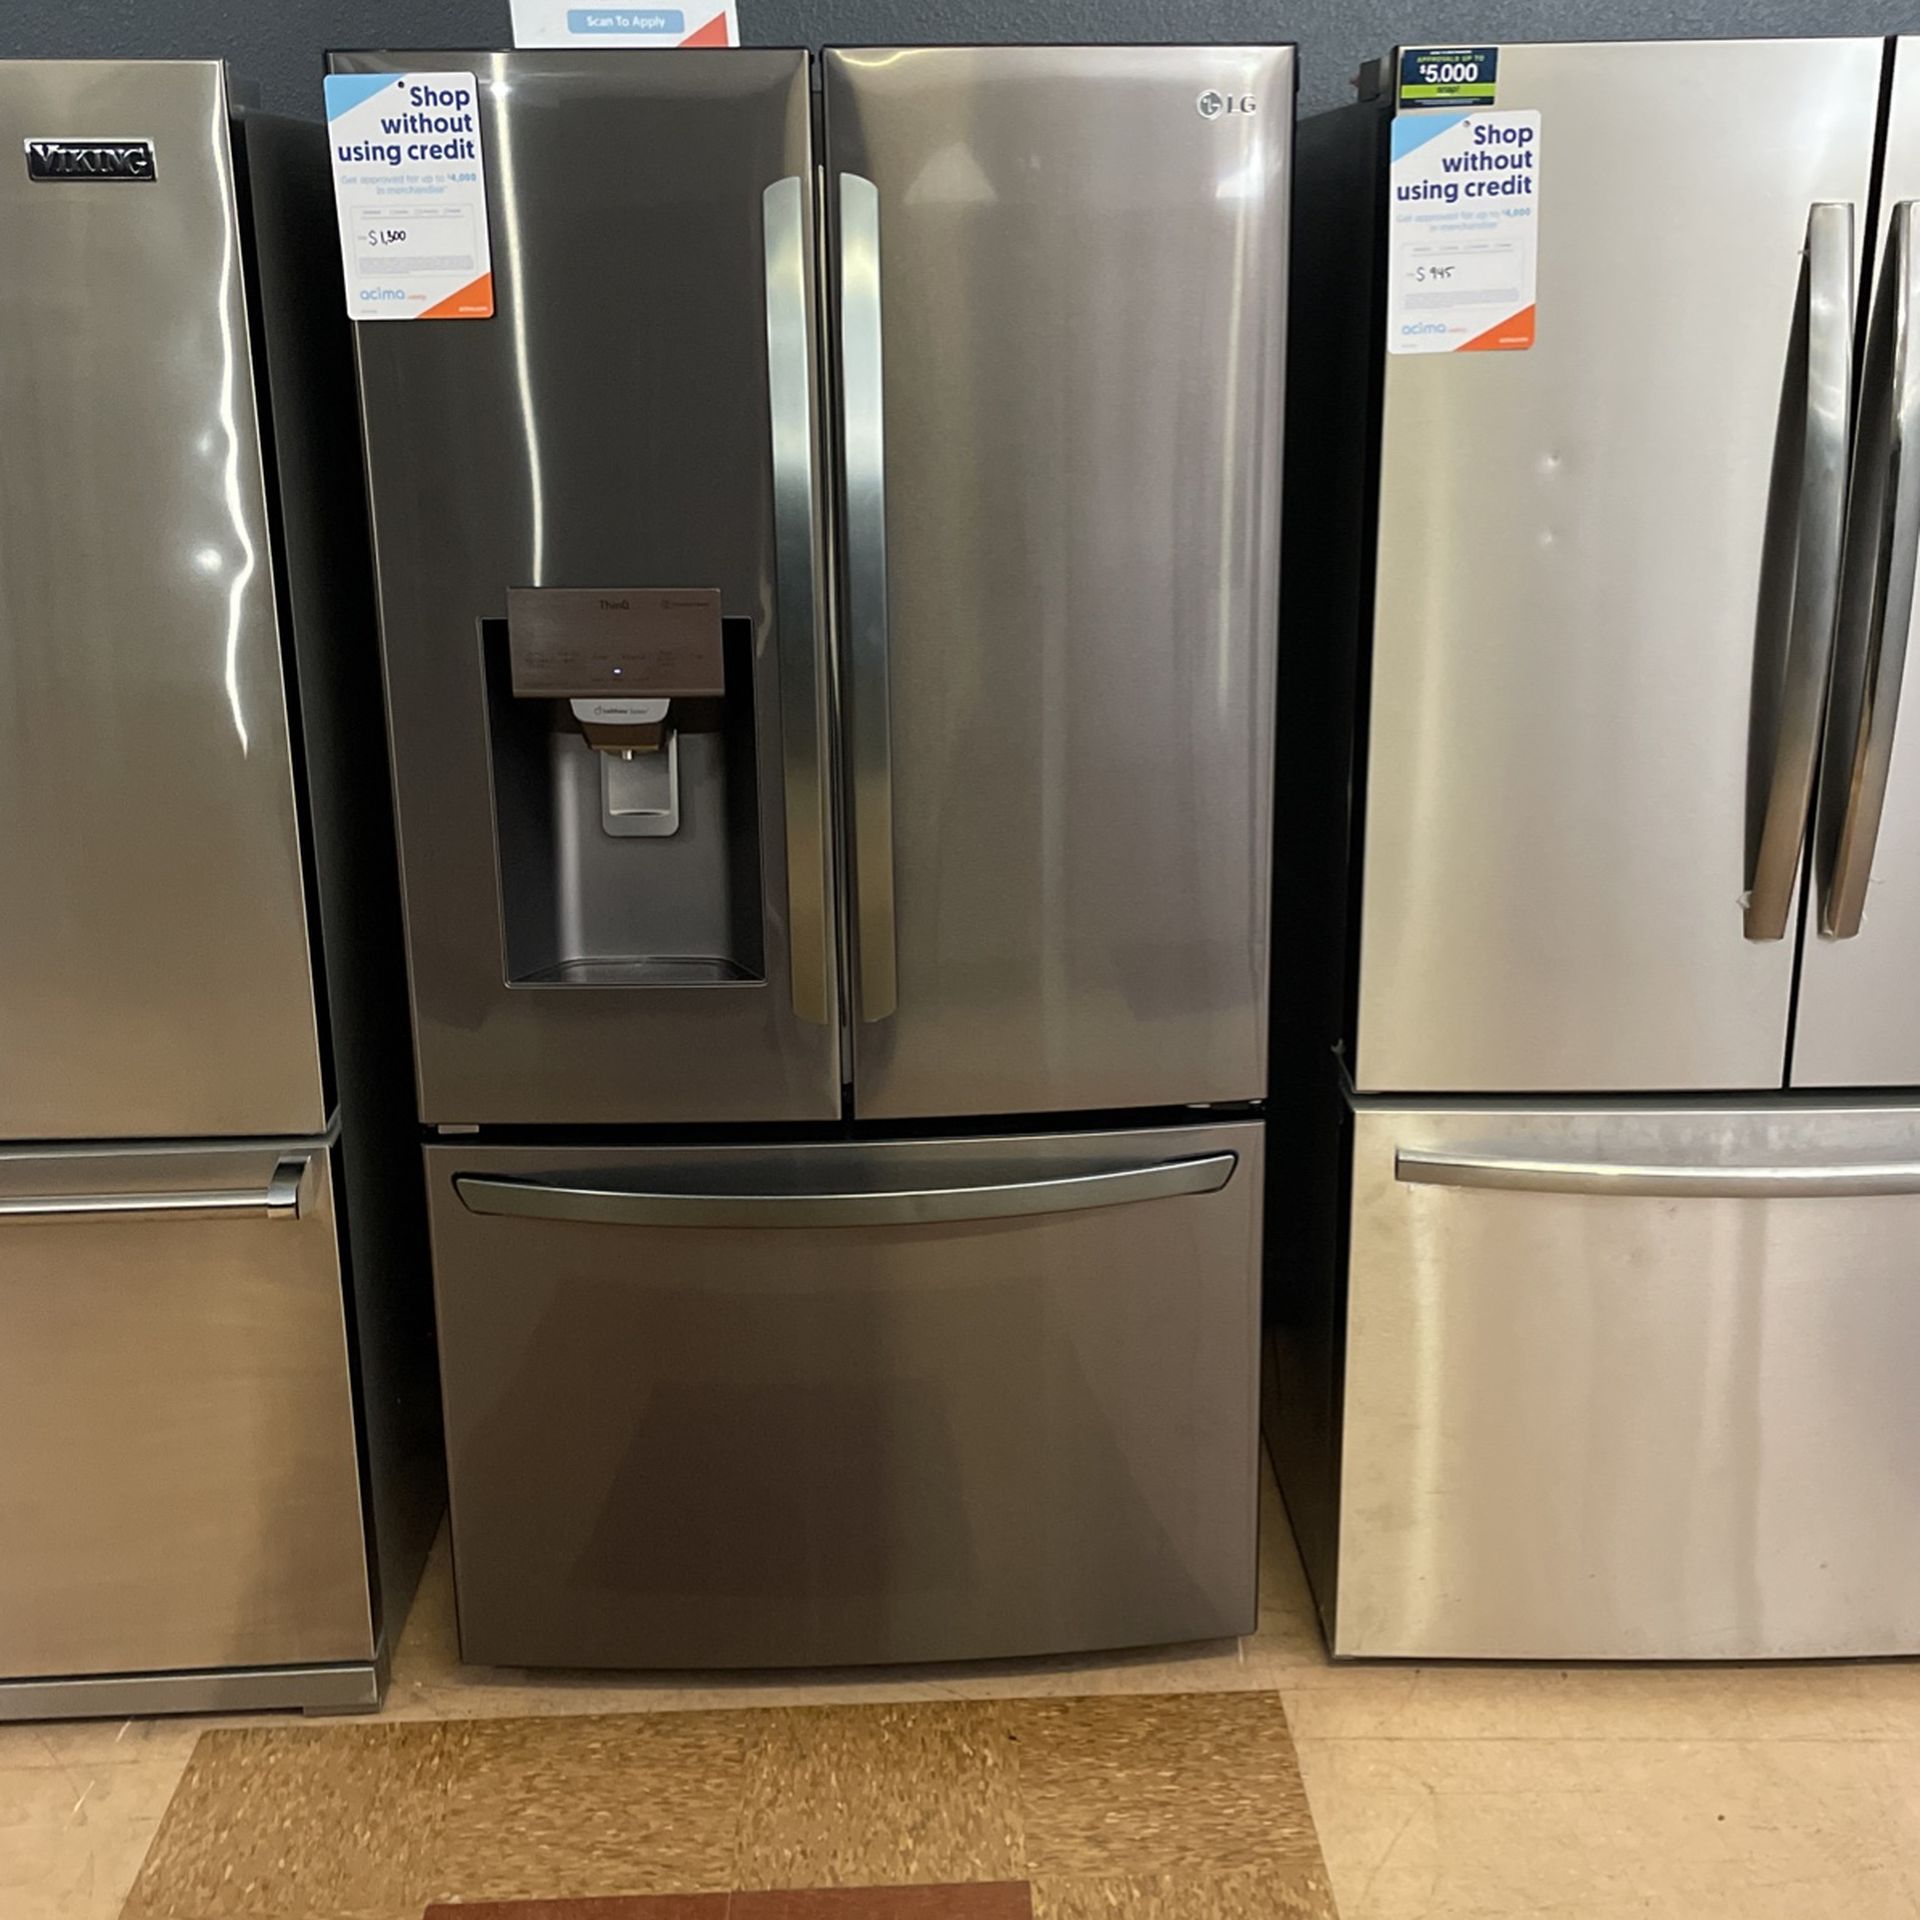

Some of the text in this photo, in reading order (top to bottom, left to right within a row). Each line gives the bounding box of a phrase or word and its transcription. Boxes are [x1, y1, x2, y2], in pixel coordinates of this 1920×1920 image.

[586, 15, 665, 29] Scan To Apply
[410, 86, 470, 111] Shop
[1227, 95, 1257, 114] LG
[381, 113, 473, 134] without
[1473, 124, 1533, 148] Shop
[31, 144, 148, 174] VIKING
[338, 139, 475, 165] using credit
[1442, 150, 1533, 172] without
[1397, 174, 1532, 203] using credit
[360, 286, 405, 300] acima
[1401, 322, 1446, 335] acima
